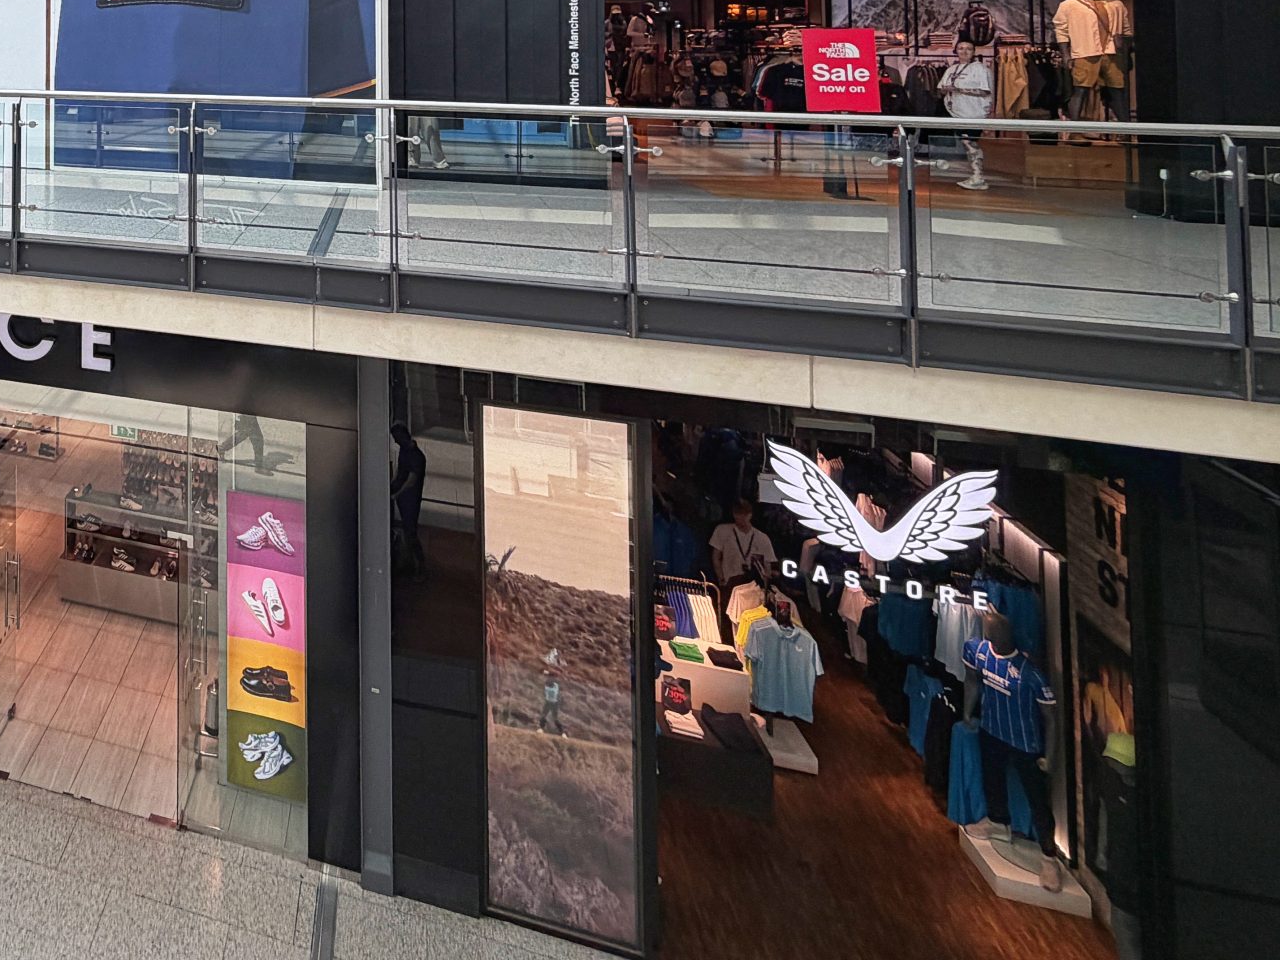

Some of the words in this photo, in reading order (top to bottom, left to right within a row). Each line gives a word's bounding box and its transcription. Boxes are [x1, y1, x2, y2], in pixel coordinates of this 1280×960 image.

[568, 51, 580, 75] Face
[812, 63, 871, 82] Sale
[569, 78, 580, 105] North
[819, 85, 846, 93] now
[848, 85, 866, 93] on
[781, 560, 989, 611] CASTORE
